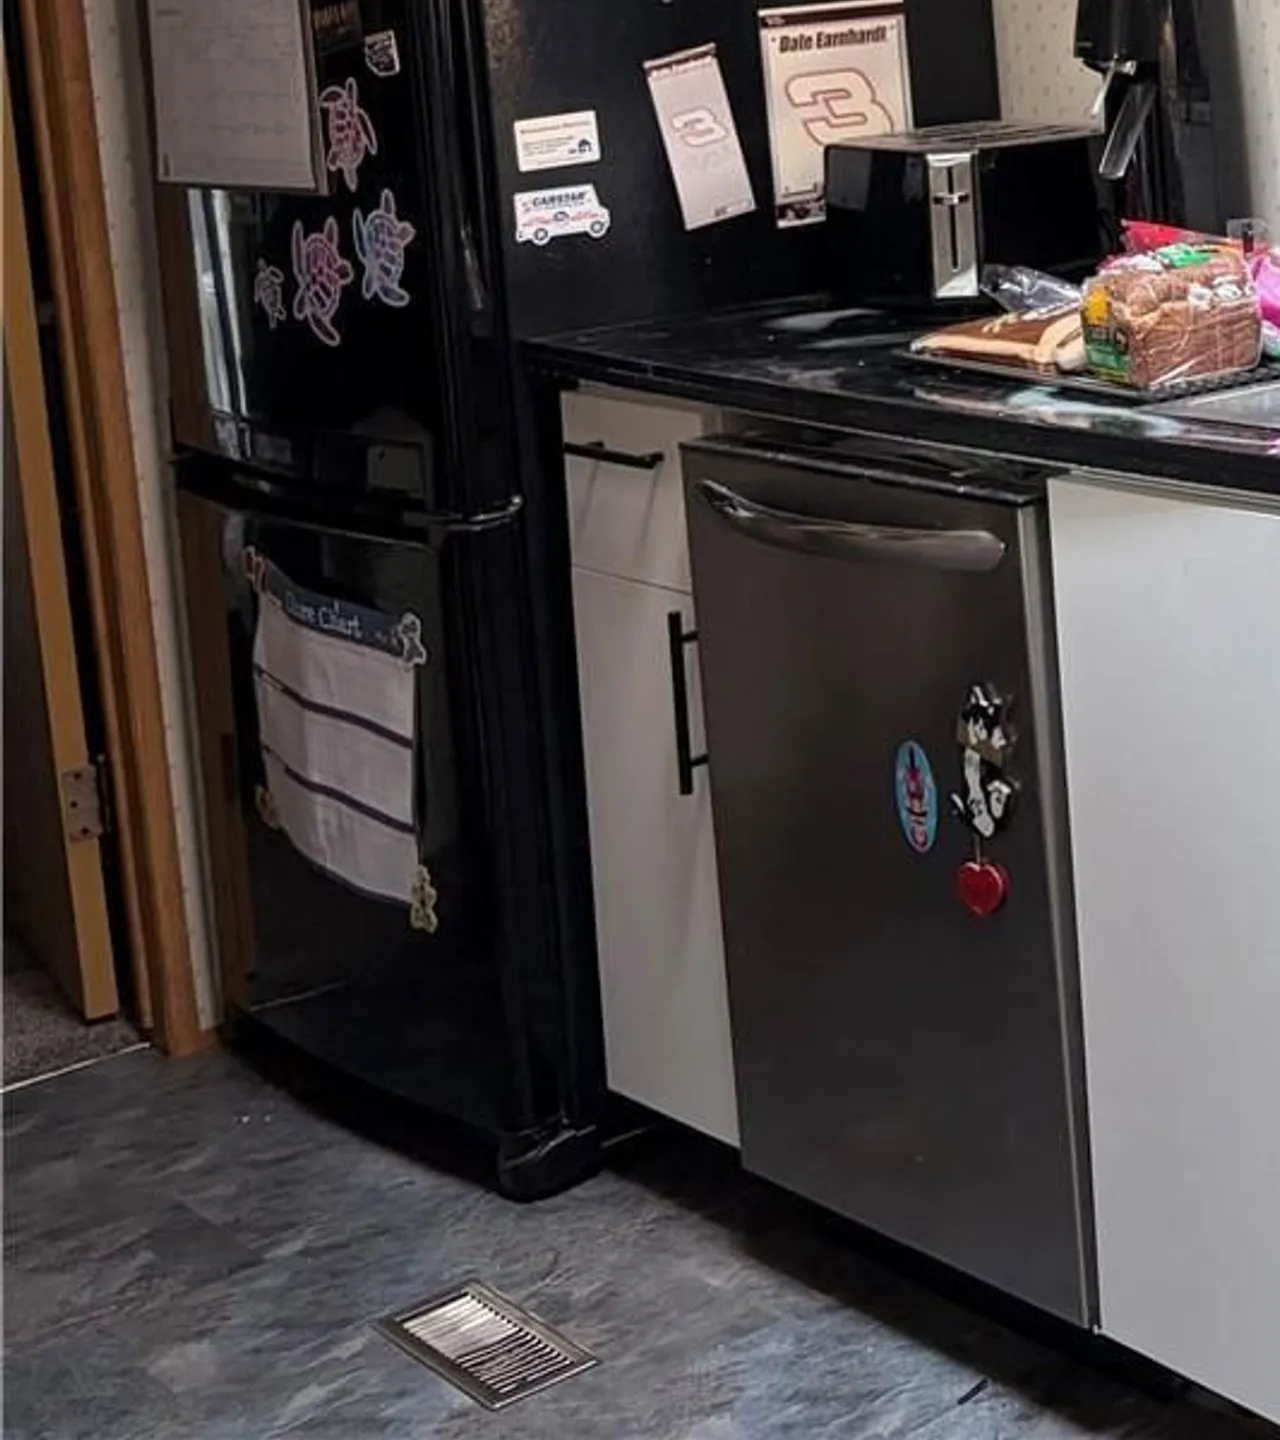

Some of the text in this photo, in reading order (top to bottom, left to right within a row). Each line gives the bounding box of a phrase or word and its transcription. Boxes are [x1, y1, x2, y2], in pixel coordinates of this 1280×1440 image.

[779, 24, 888, 53] Dale Earnhardt
[671, 106, 729, 148] 3
[785, 67, 895, 146] 3
